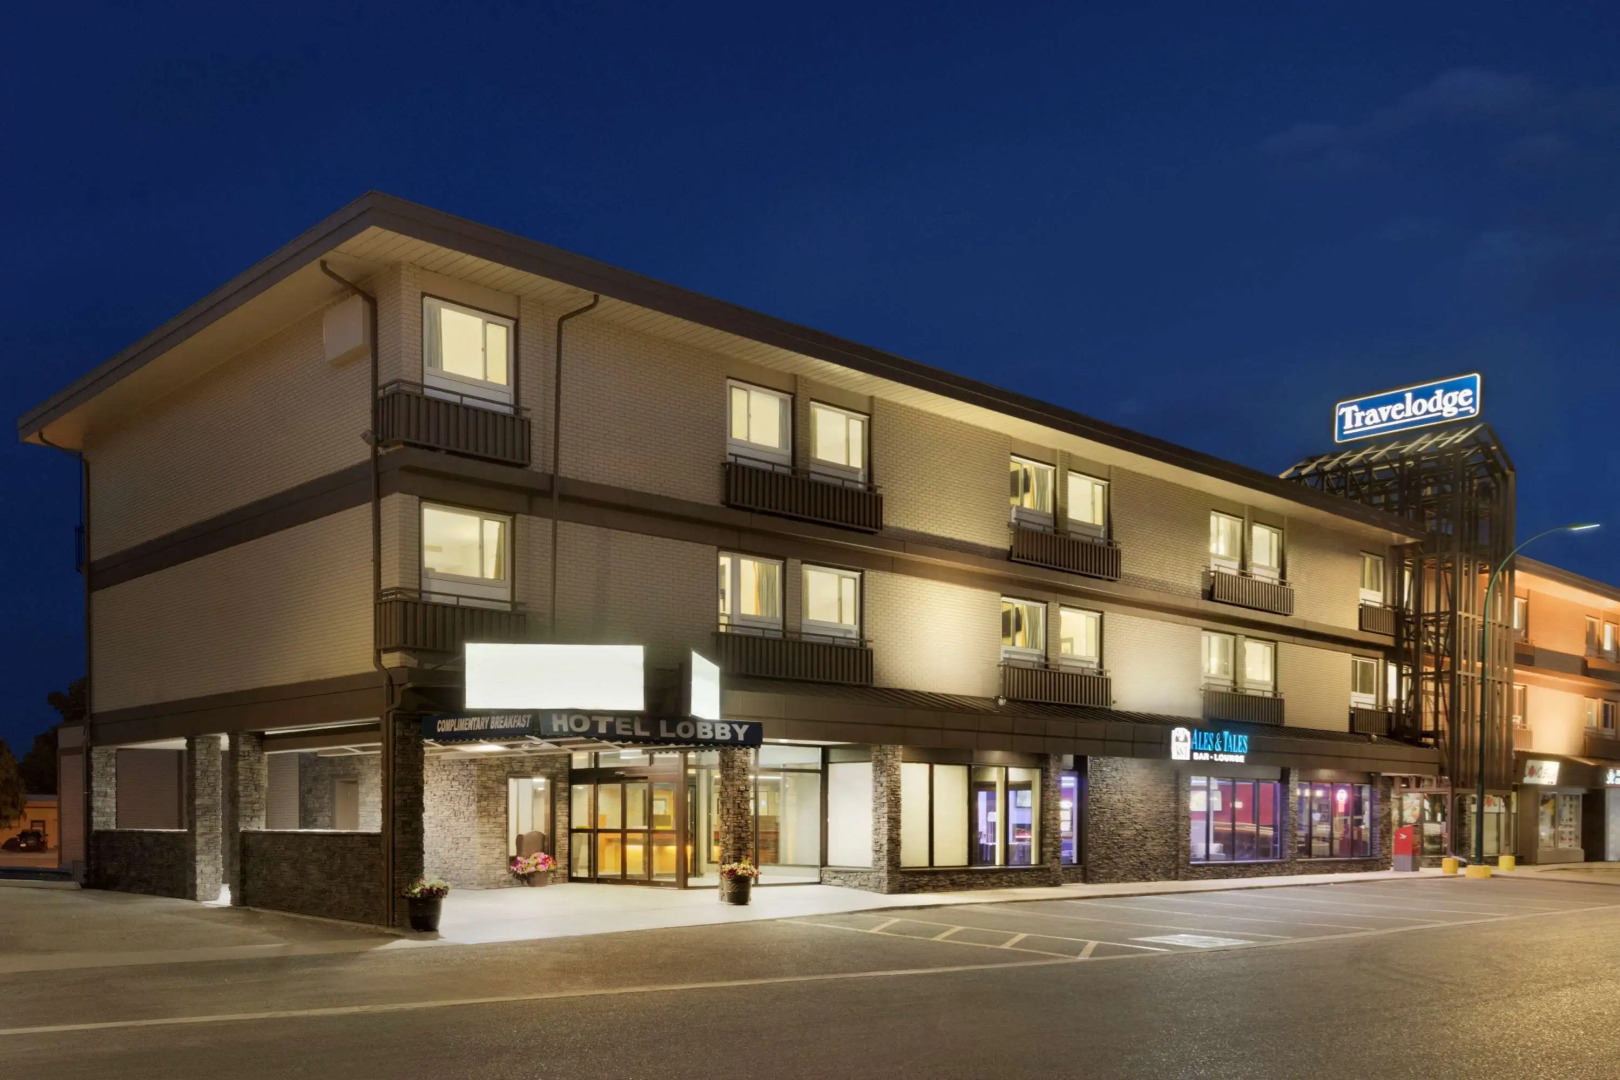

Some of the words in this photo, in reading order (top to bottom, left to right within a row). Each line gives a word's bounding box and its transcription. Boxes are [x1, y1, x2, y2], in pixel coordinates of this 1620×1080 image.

[1339, 389, 1473, 429] Travelodge
[436, 716, 490, 732] COMPLIMENTARY
[490, 714, 532, 729] BREAKFAST
[551, 713, 650, 737] HOTEL
[660, 719, 750, 741] LOBBY
[1191, 728, 1214, 751] ALES
[1222, 731, 1248, 753] TALES
[1193, 752, 1210, 761] BAR
[1214, 753, 1245, 763] LOUNGE
